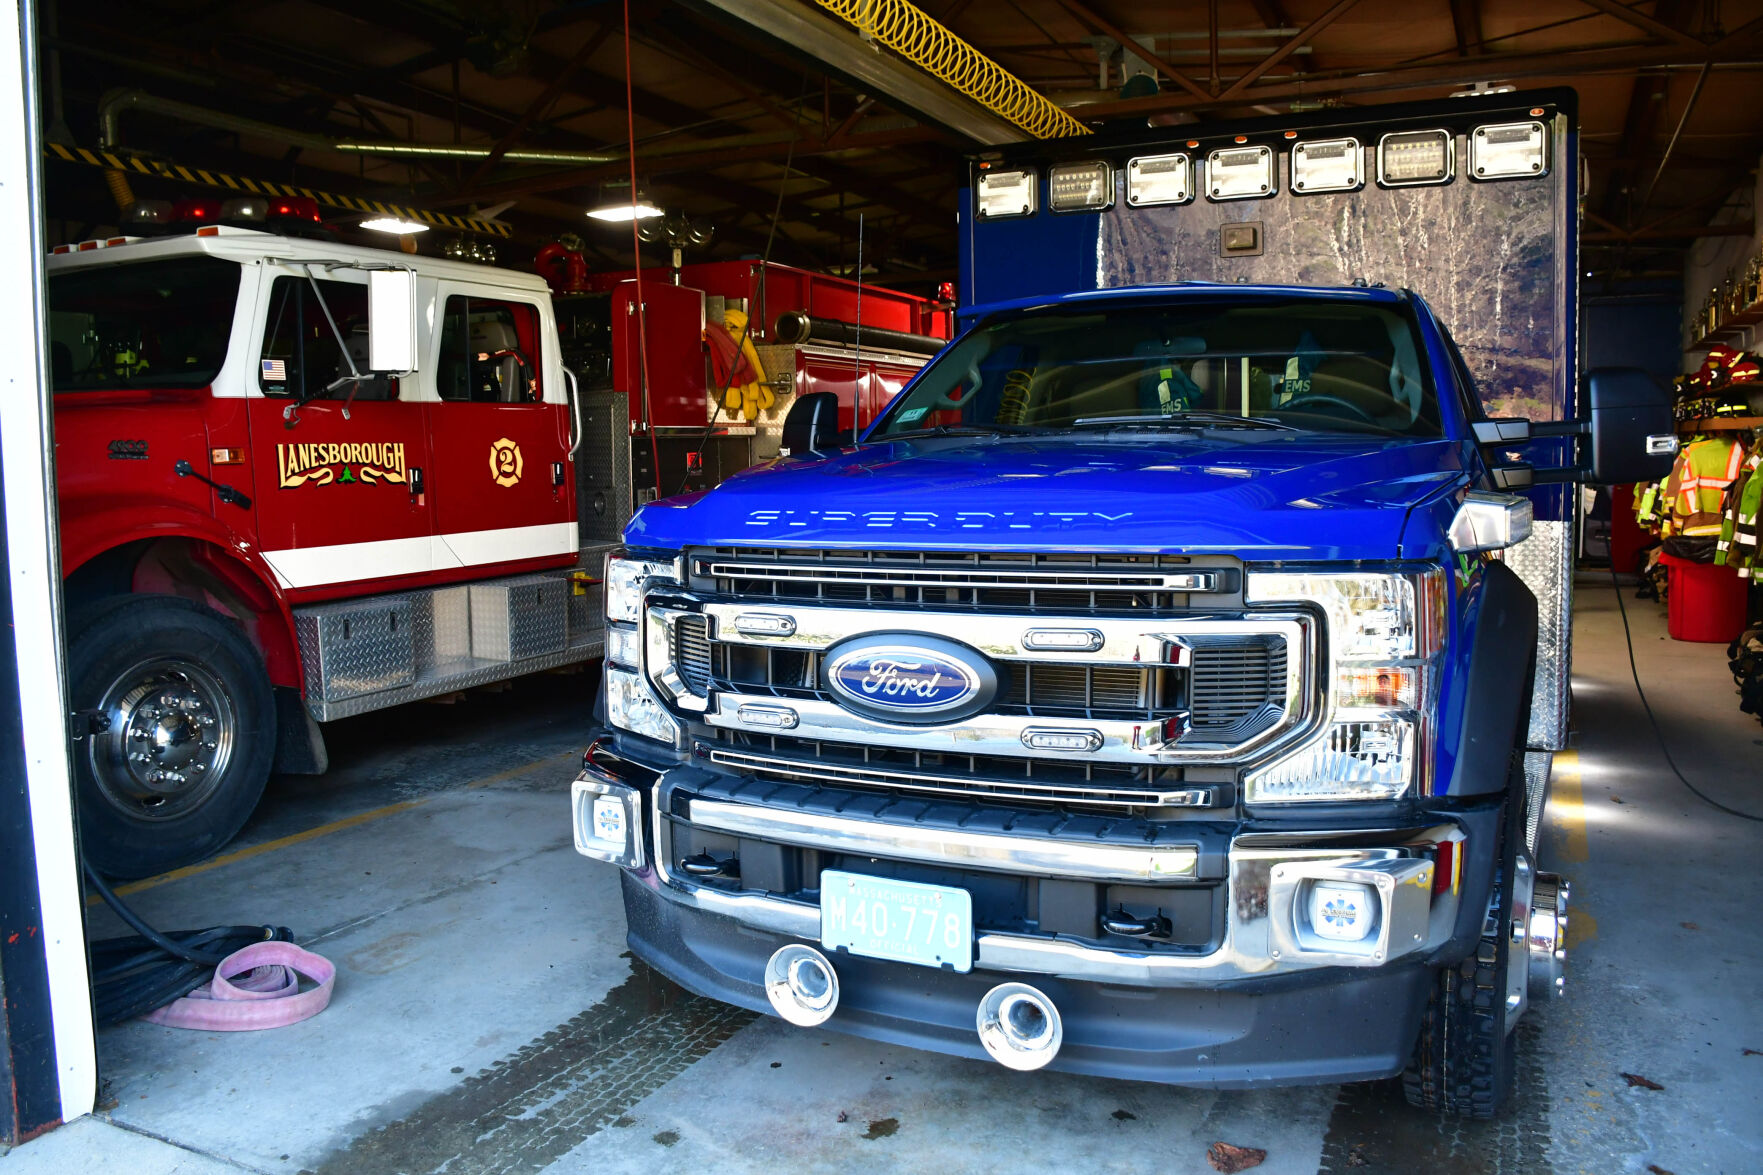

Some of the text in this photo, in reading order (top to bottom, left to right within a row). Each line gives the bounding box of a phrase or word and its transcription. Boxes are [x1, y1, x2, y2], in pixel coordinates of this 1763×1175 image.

[1285, 379, 1311, 392] EMS
[1161, 398, 1182, 415] EMS
[277, 442, 406, 489] LANESBOROUGH
[499, 449, 515, 473] 2
[745, 509, 1134, 531] SUPER DUTY
[861, 659, 942, 698] Ford
[848, 885, 943, 909] MASSACHUSETTS
[870, 938, 919, 956] OFFICIAL
